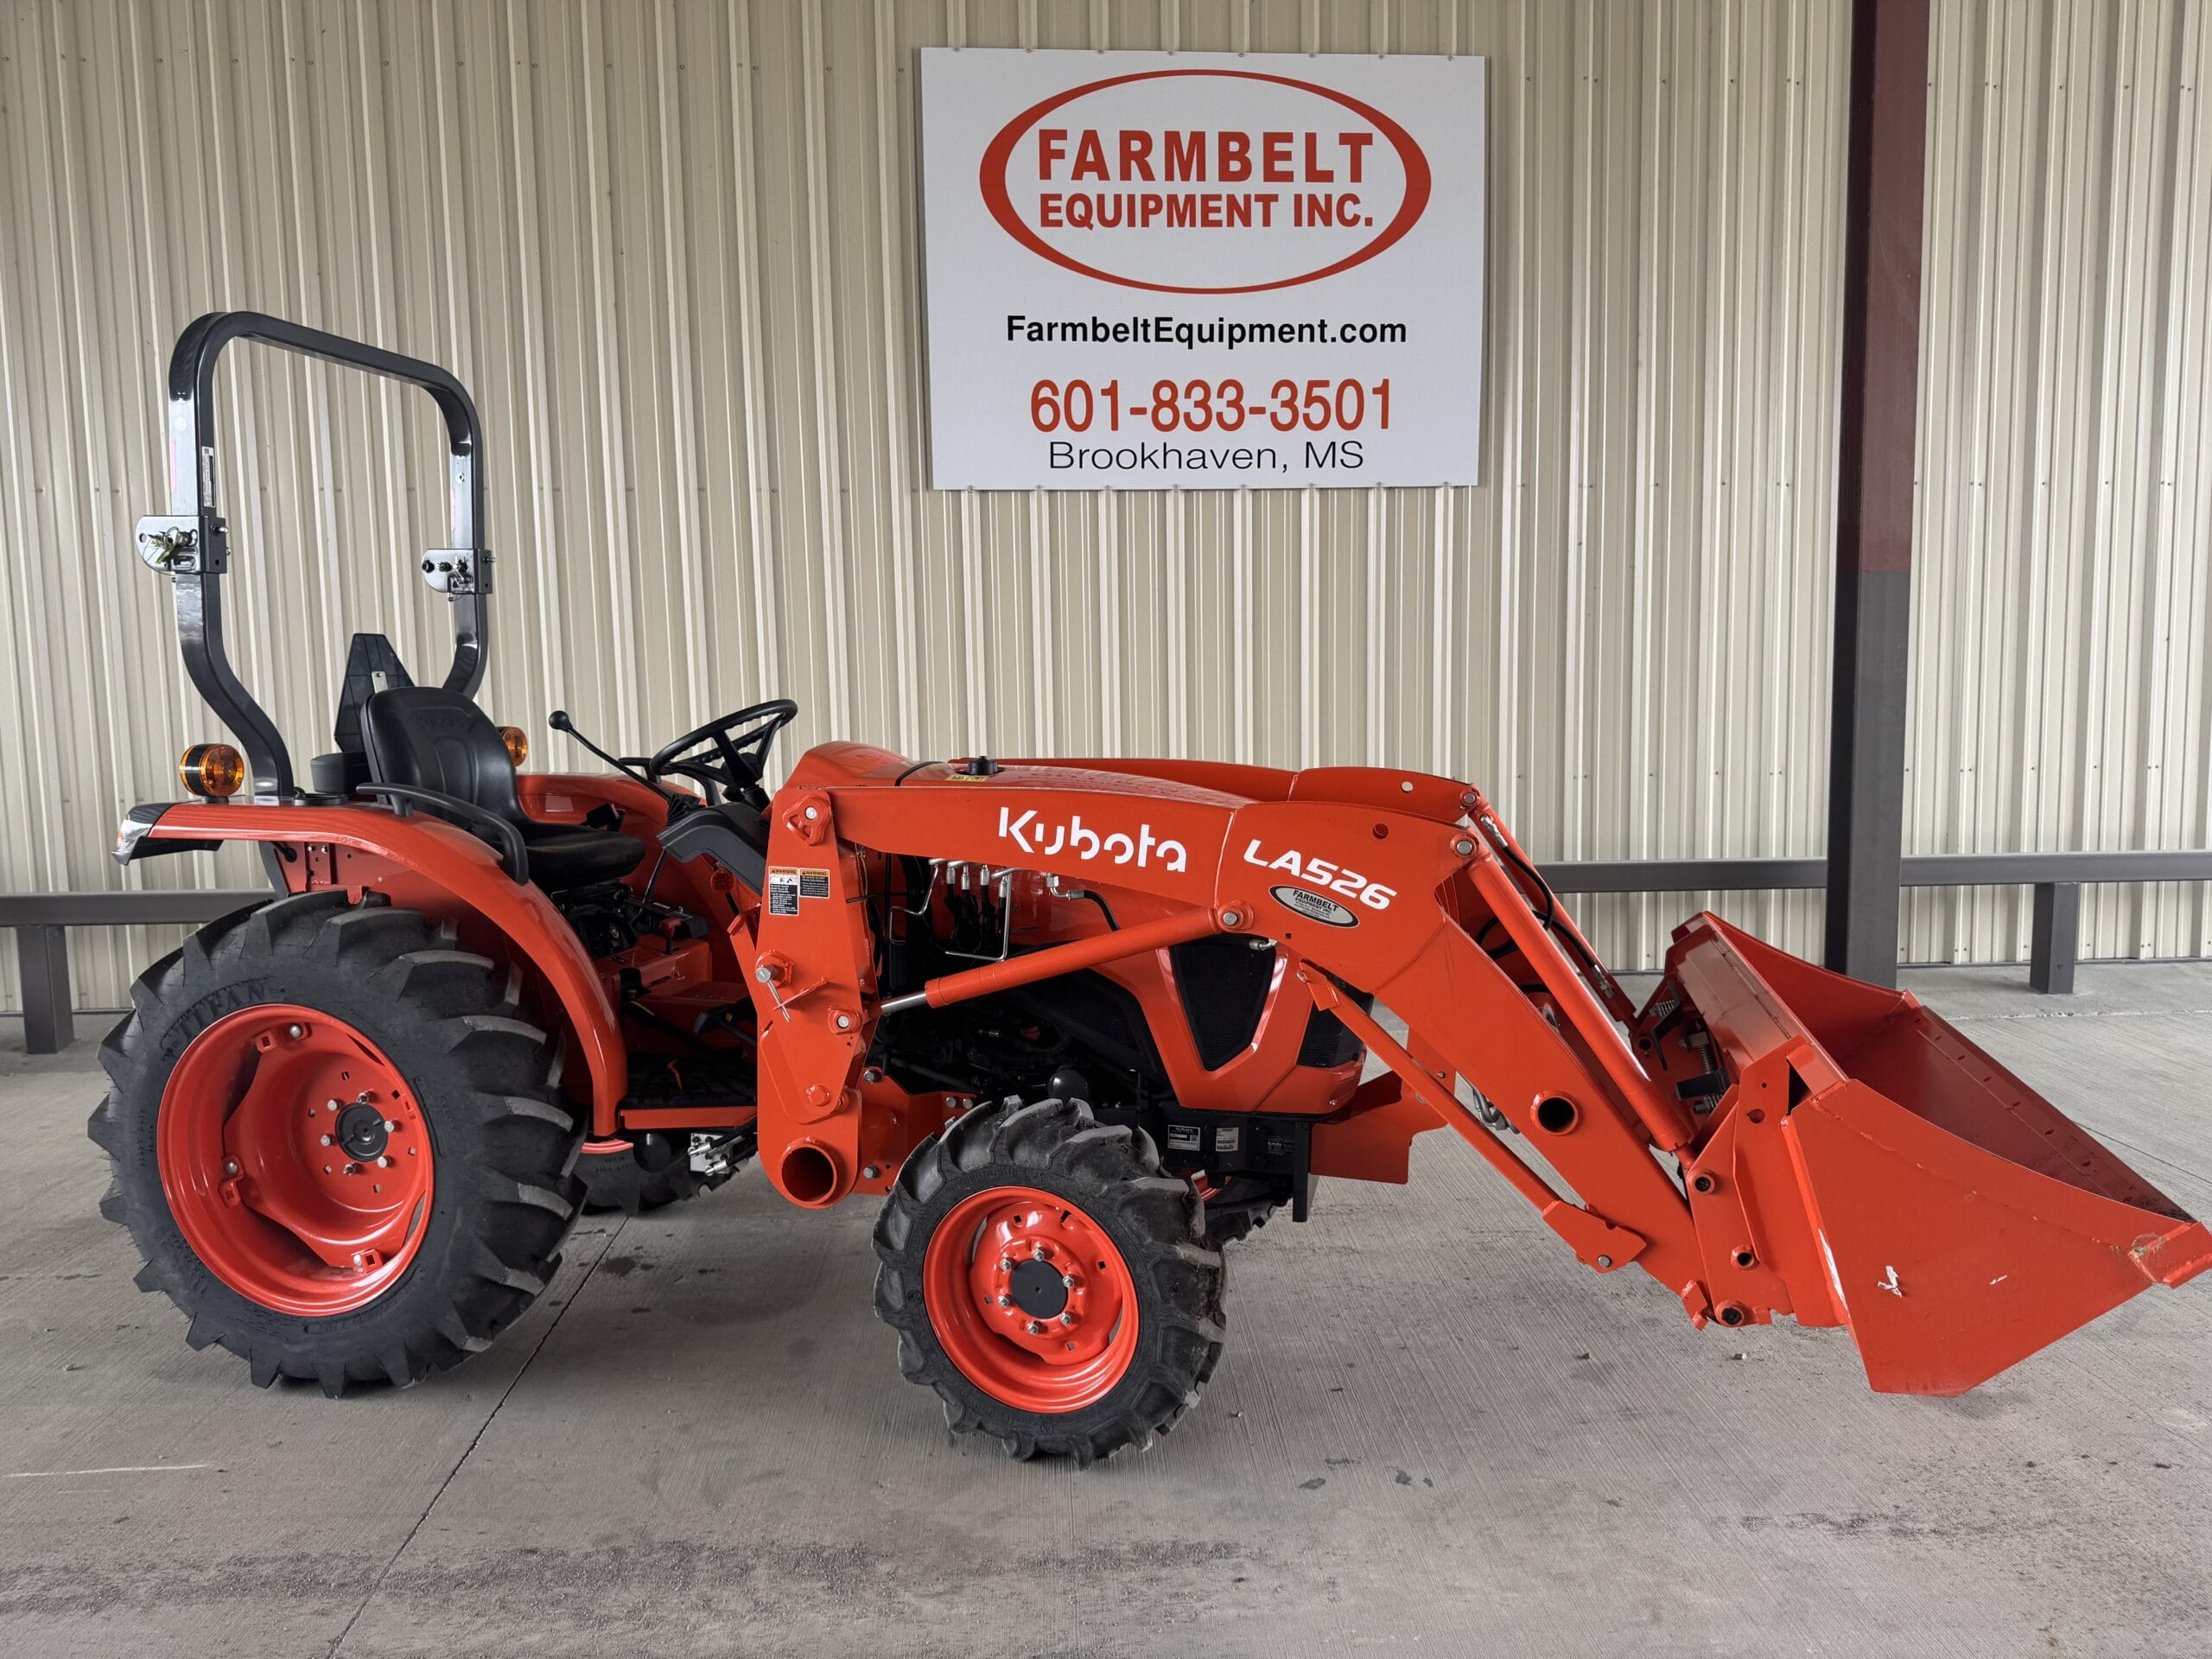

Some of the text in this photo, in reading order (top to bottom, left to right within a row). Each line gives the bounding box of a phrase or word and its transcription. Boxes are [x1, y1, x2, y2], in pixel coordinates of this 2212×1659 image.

[1038, 129, 1373, 183] FARMBELT
[1039, 193, 1373, 231] EQUIPMENT INC.
[1007, 315, 1407, 349] FarmbeltEquipment.com
[1031, 378, 1390, 433] 601-833-3501
[1049, 440, 1363, 473] Brookhaven, MS
[998, 806, 1186, 873] Kubota
[1243, 839, 1397, 911] LA526
[1293, 889, 1339, 912] FARMBELT
[1294, 897, 1323, 911] EQUIPMENT
[172, 979, 266, 1039] TITAN
